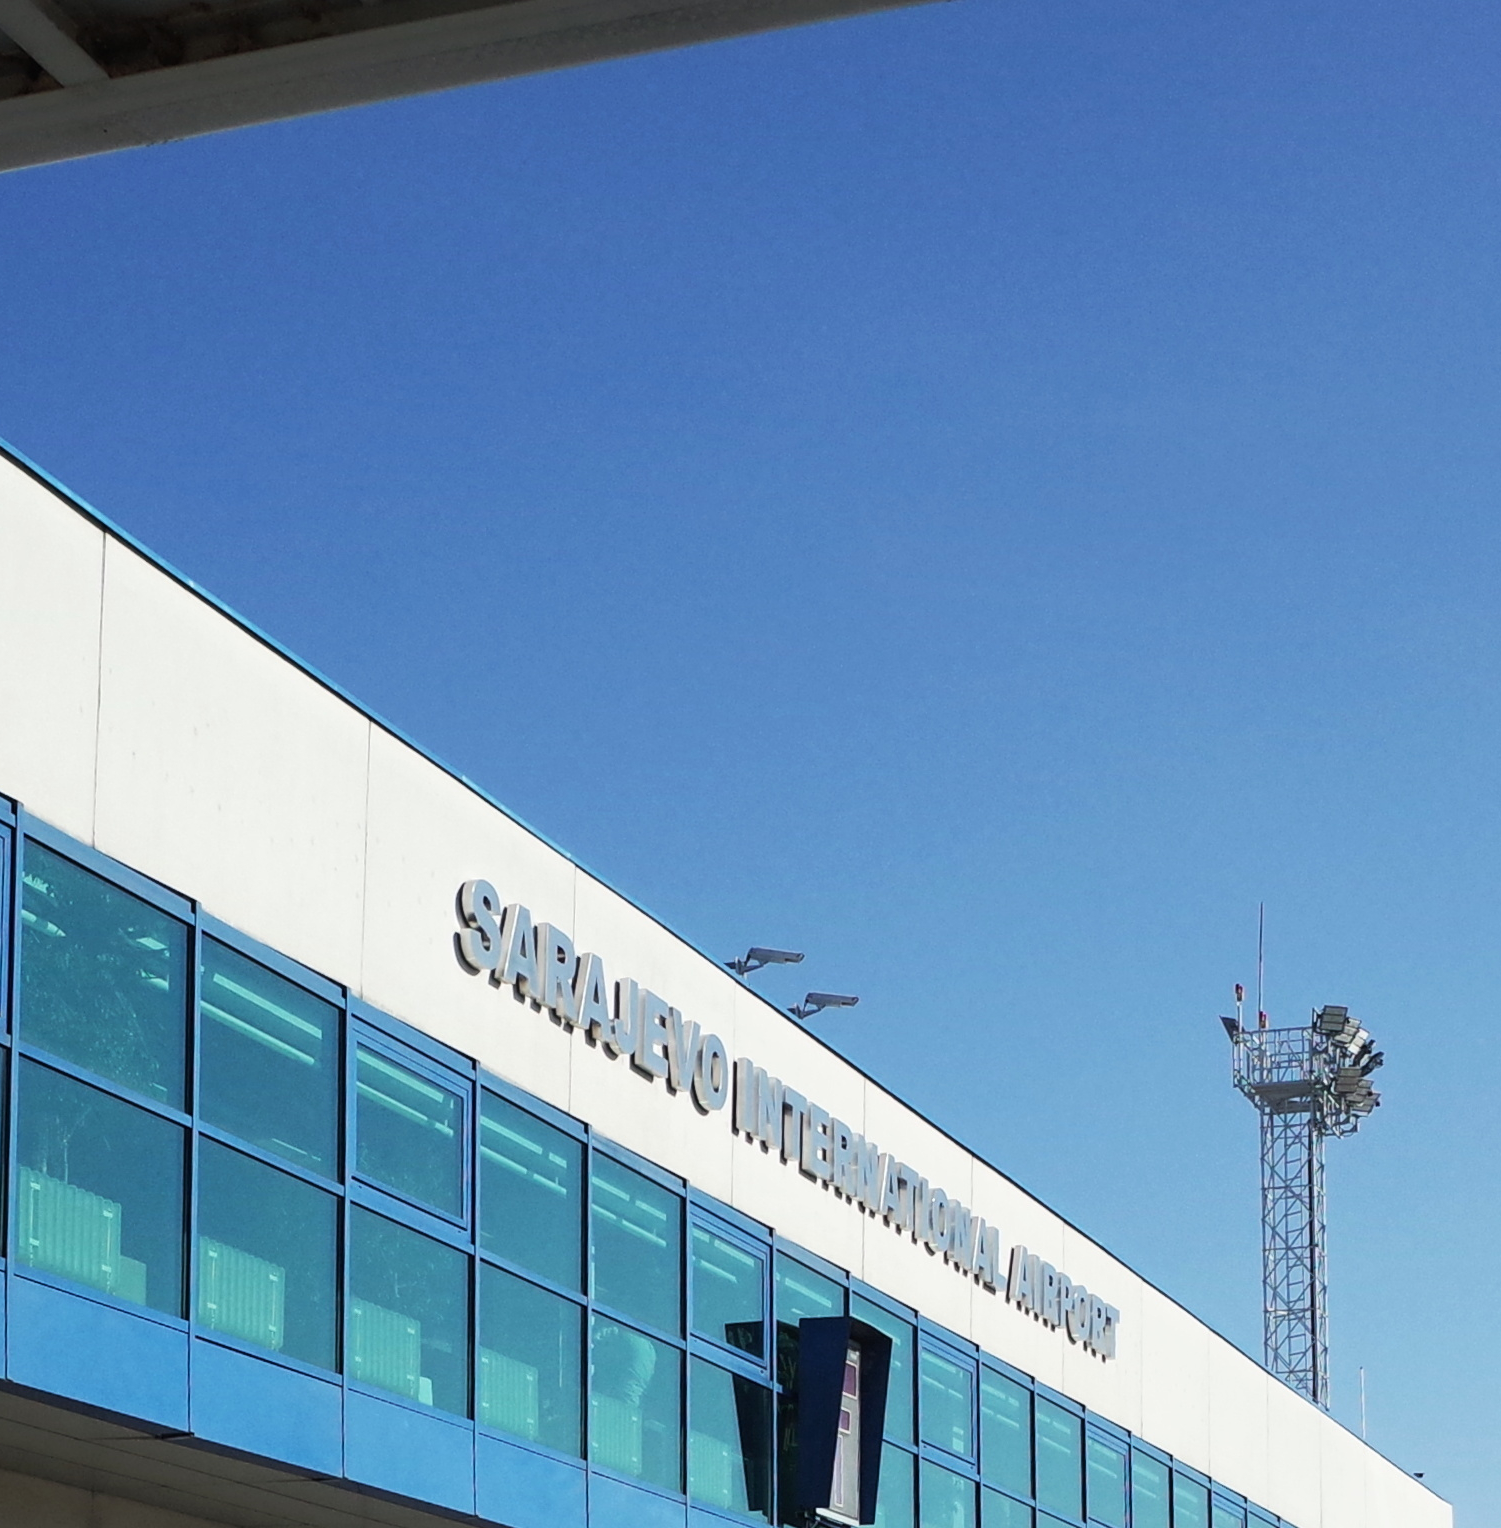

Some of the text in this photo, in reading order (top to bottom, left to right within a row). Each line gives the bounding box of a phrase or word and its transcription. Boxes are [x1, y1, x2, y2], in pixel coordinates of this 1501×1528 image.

[456, 879, 1121, 1360] SARAJEVO INTERNATIONAL AIRPORT
